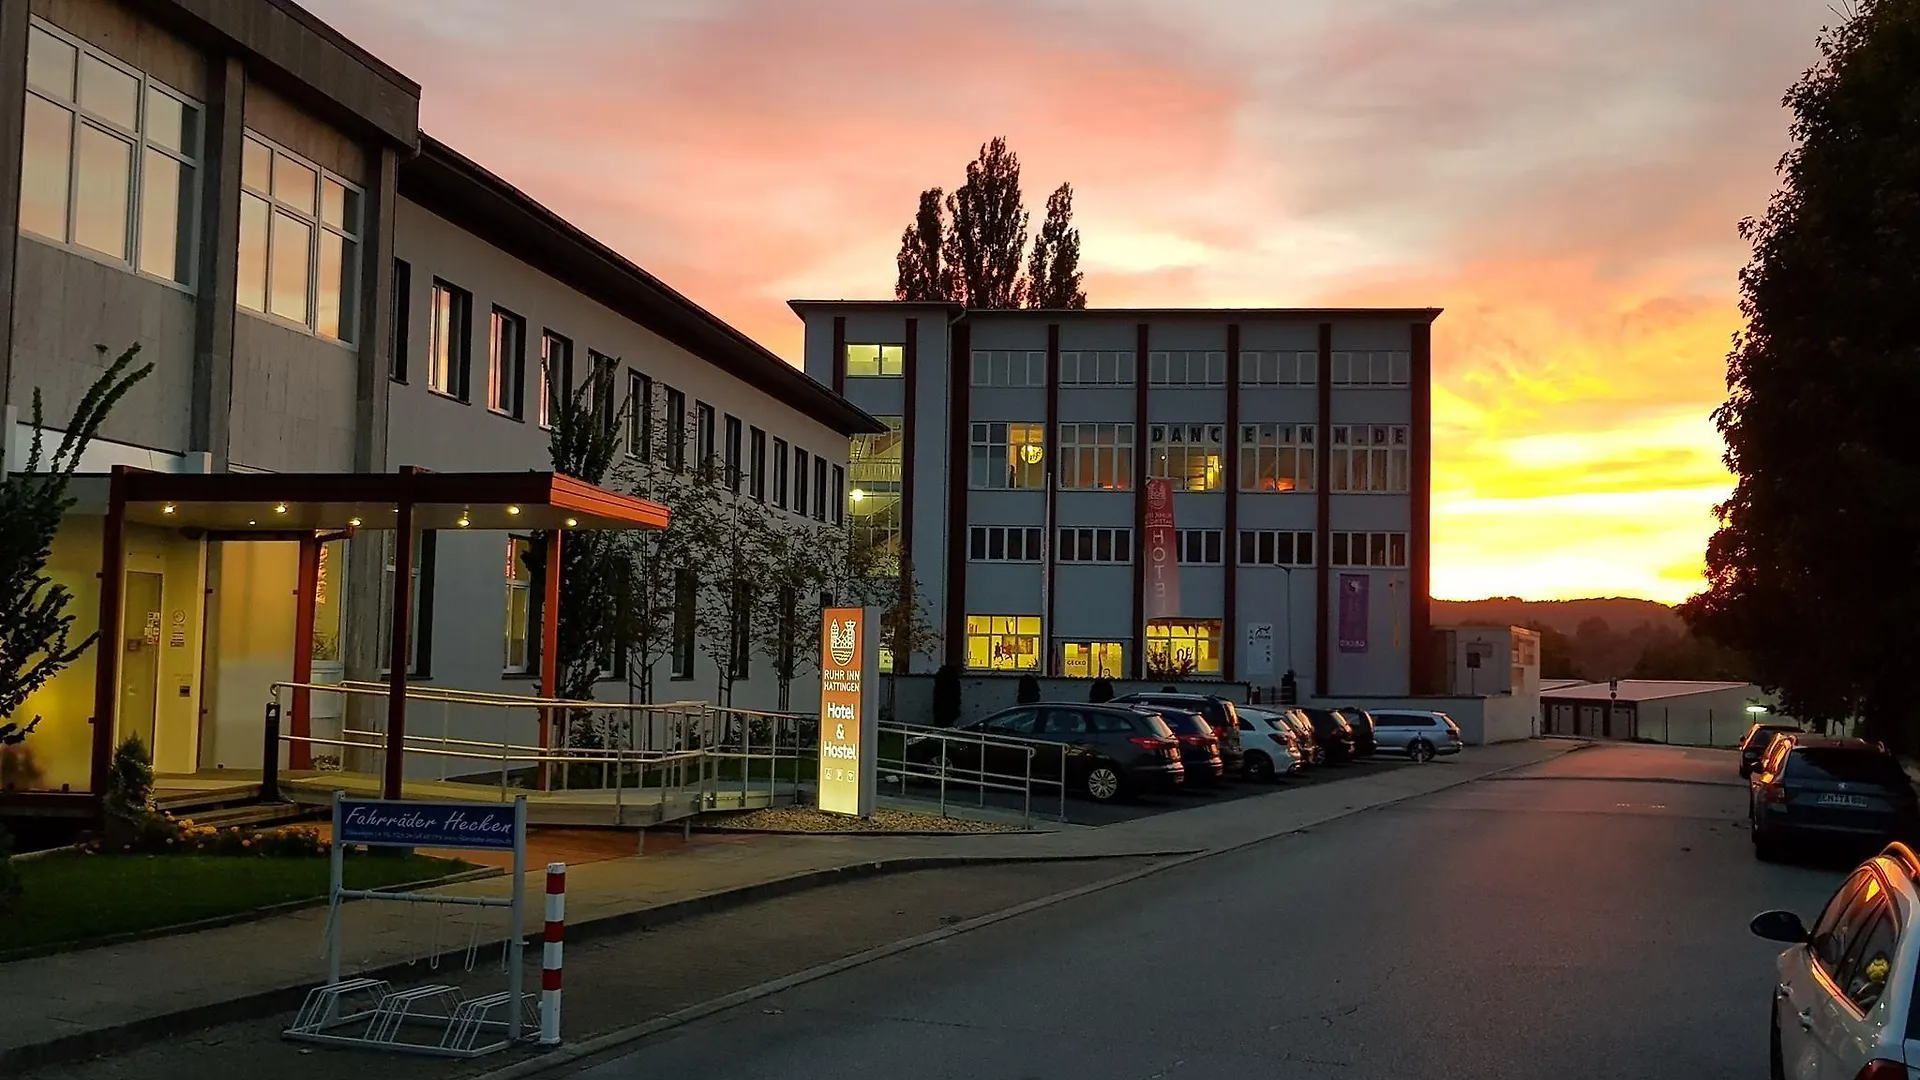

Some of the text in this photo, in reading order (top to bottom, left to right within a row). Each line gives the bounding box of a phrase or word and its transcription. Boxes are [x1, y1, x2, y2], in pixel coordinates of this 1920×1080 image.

[824, 669, 860, 681] RUHR INN
[824, 681, 860, 692] HATTINGEN
[827, 702, 855, 720] Hotel
[836, 723, 845, 740] &
[823, 741, 857, 760] Hostel
[345, 806, 512, 834] Fahrräder Hecken
